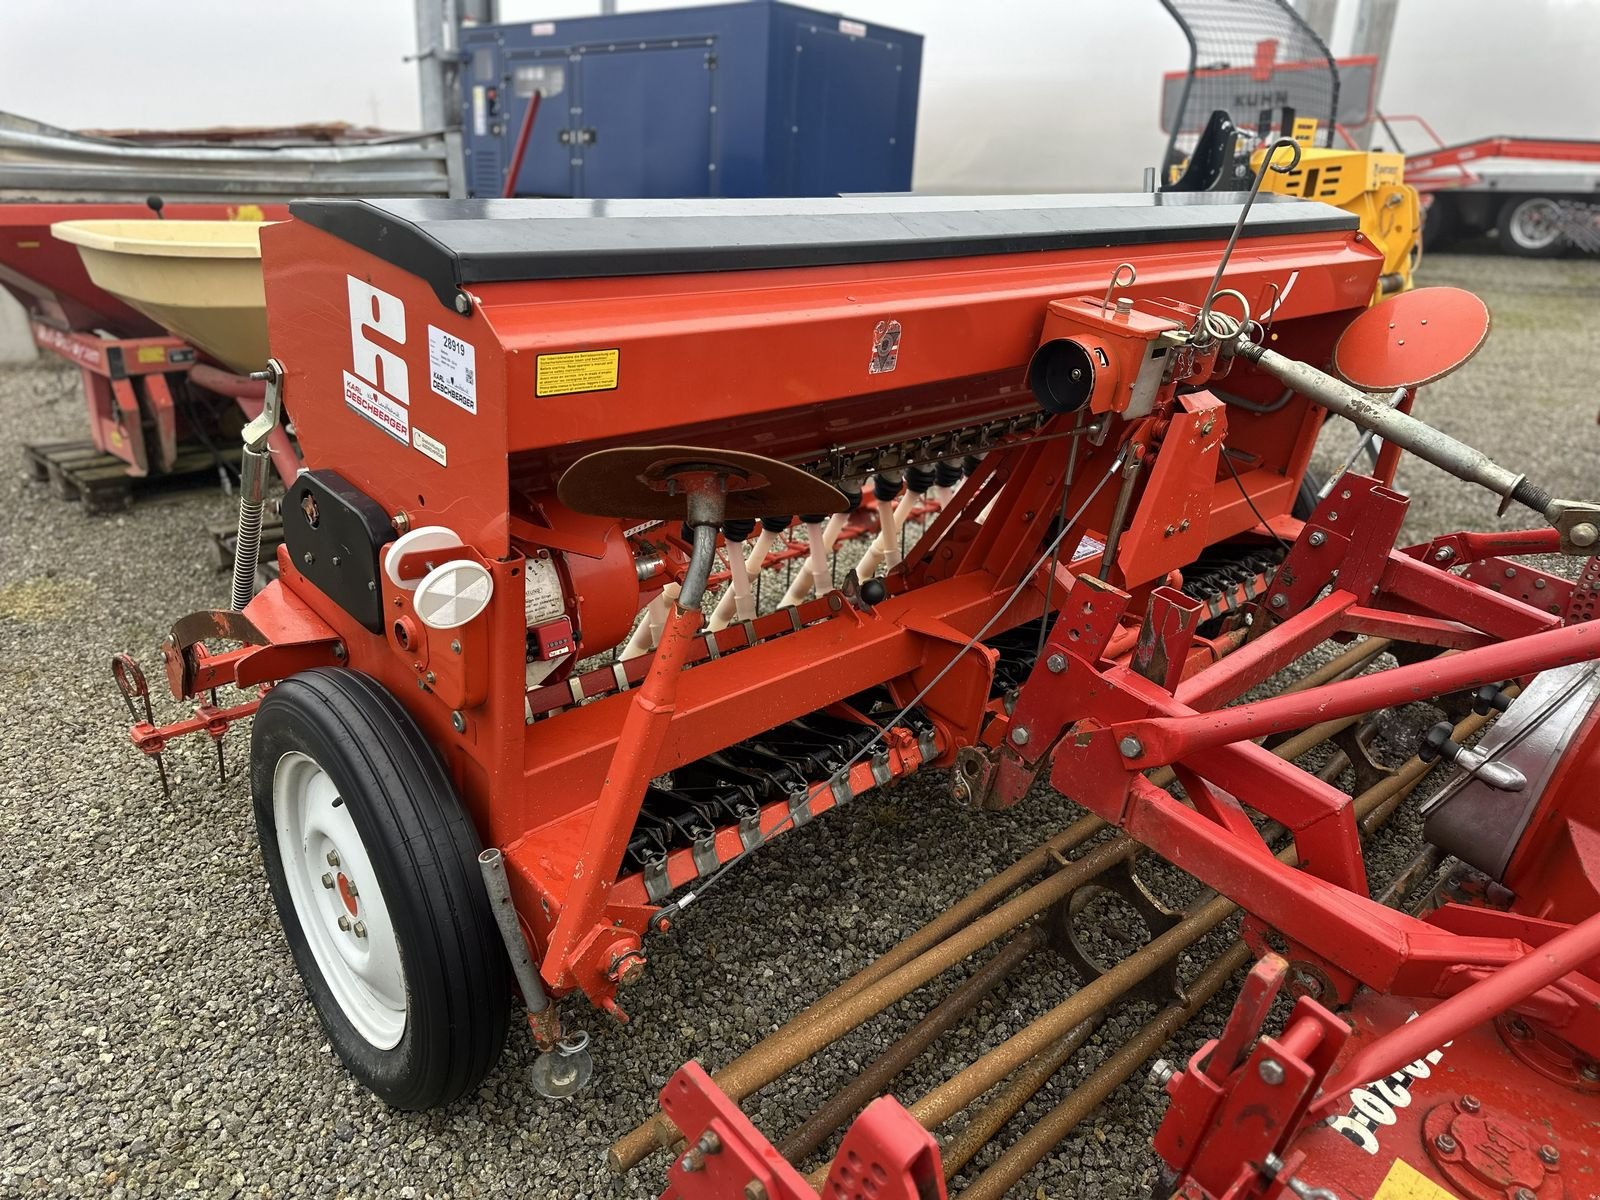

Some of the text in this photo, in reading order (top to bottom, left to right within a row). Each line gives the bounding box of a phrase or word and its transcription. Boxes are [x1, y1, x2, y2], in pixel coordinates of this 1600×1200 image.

[443, 335, 465, 356] 28919
[433, 371, 445, 383] KARL
[346, 381, 363, 396] KARL
[432, 380, 475, 409] DESCHBERGER
[345, 389, 408, 436] DESCHBERGER
